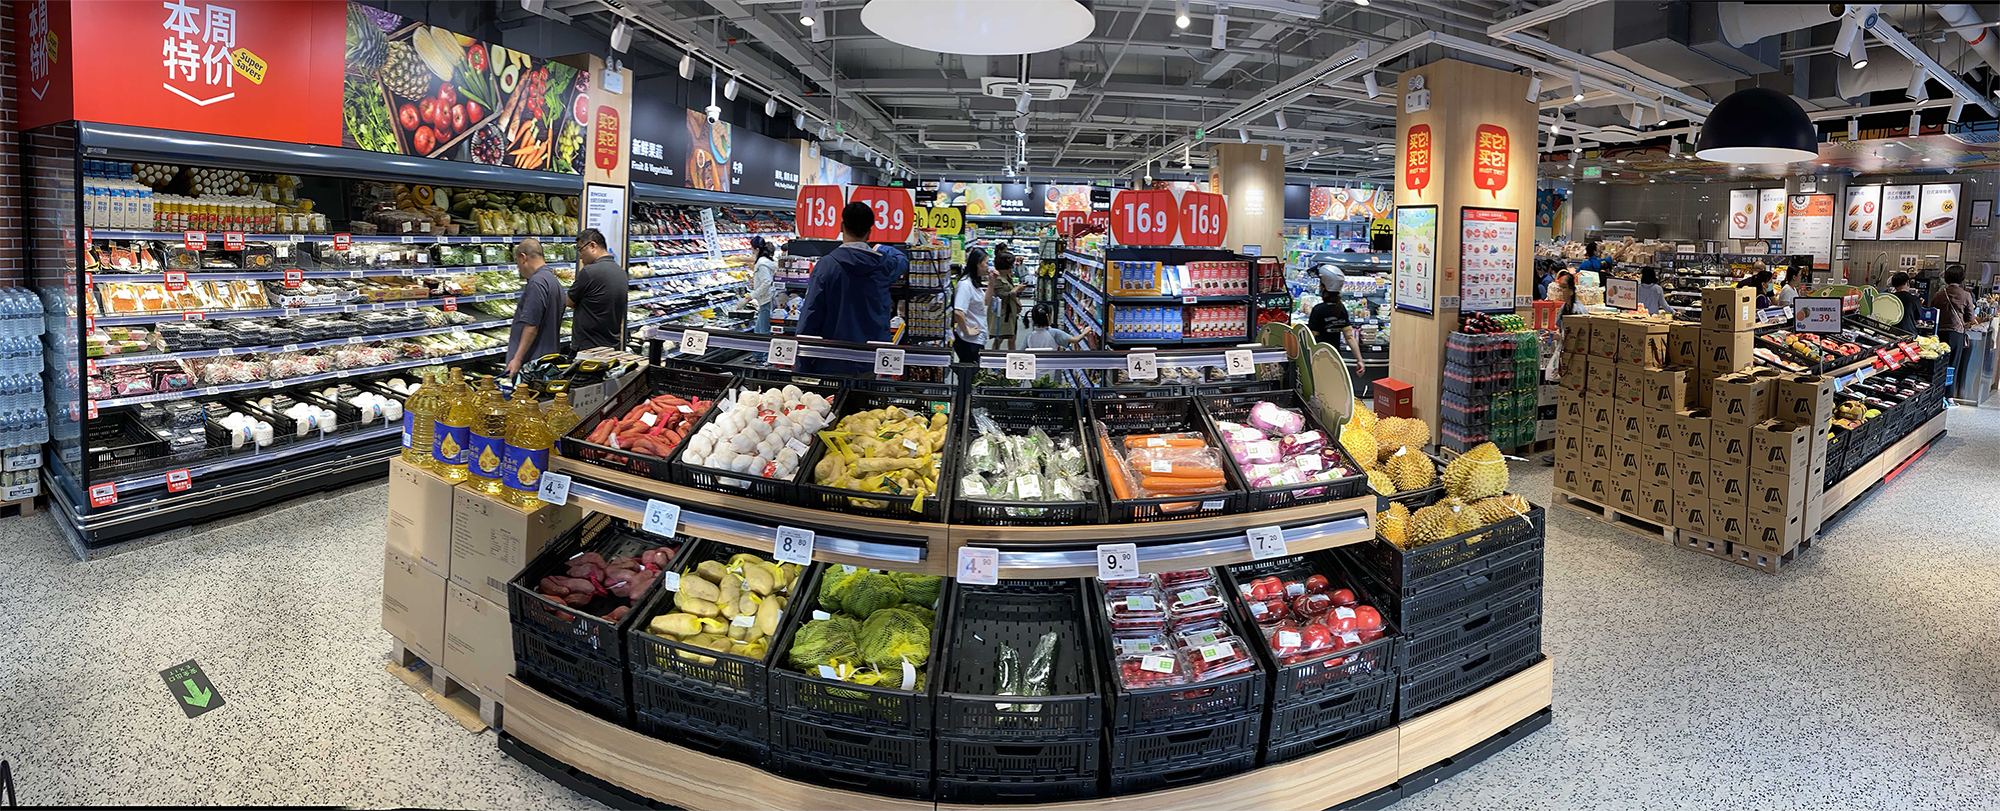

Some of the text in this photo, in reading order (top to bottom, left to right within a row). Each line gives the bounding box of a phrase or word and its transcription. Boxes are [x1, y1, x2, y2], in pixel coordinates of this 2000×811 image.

[163, 0, 236, 48] 本周
[162, 36, 234, 88] 特价
[235, 59, 262, 80] Savers
[240, 51, 263, 71] Super
[1409, 131, 1428, 149] 买它!
[1479, 131, 1506, 149] 买它!
[1409, 149, 1428, 167] 买它!
[1478, 149, 1505, 167] 买它!
[806, 197, 836, 227] 13.9
[934, 213, 956, 229] 29.0
[1124, 203, 1167, 233] 16.9
[1189, 203, 1220, 235] 16.9
[1819, 314, 1830, 322] 39
